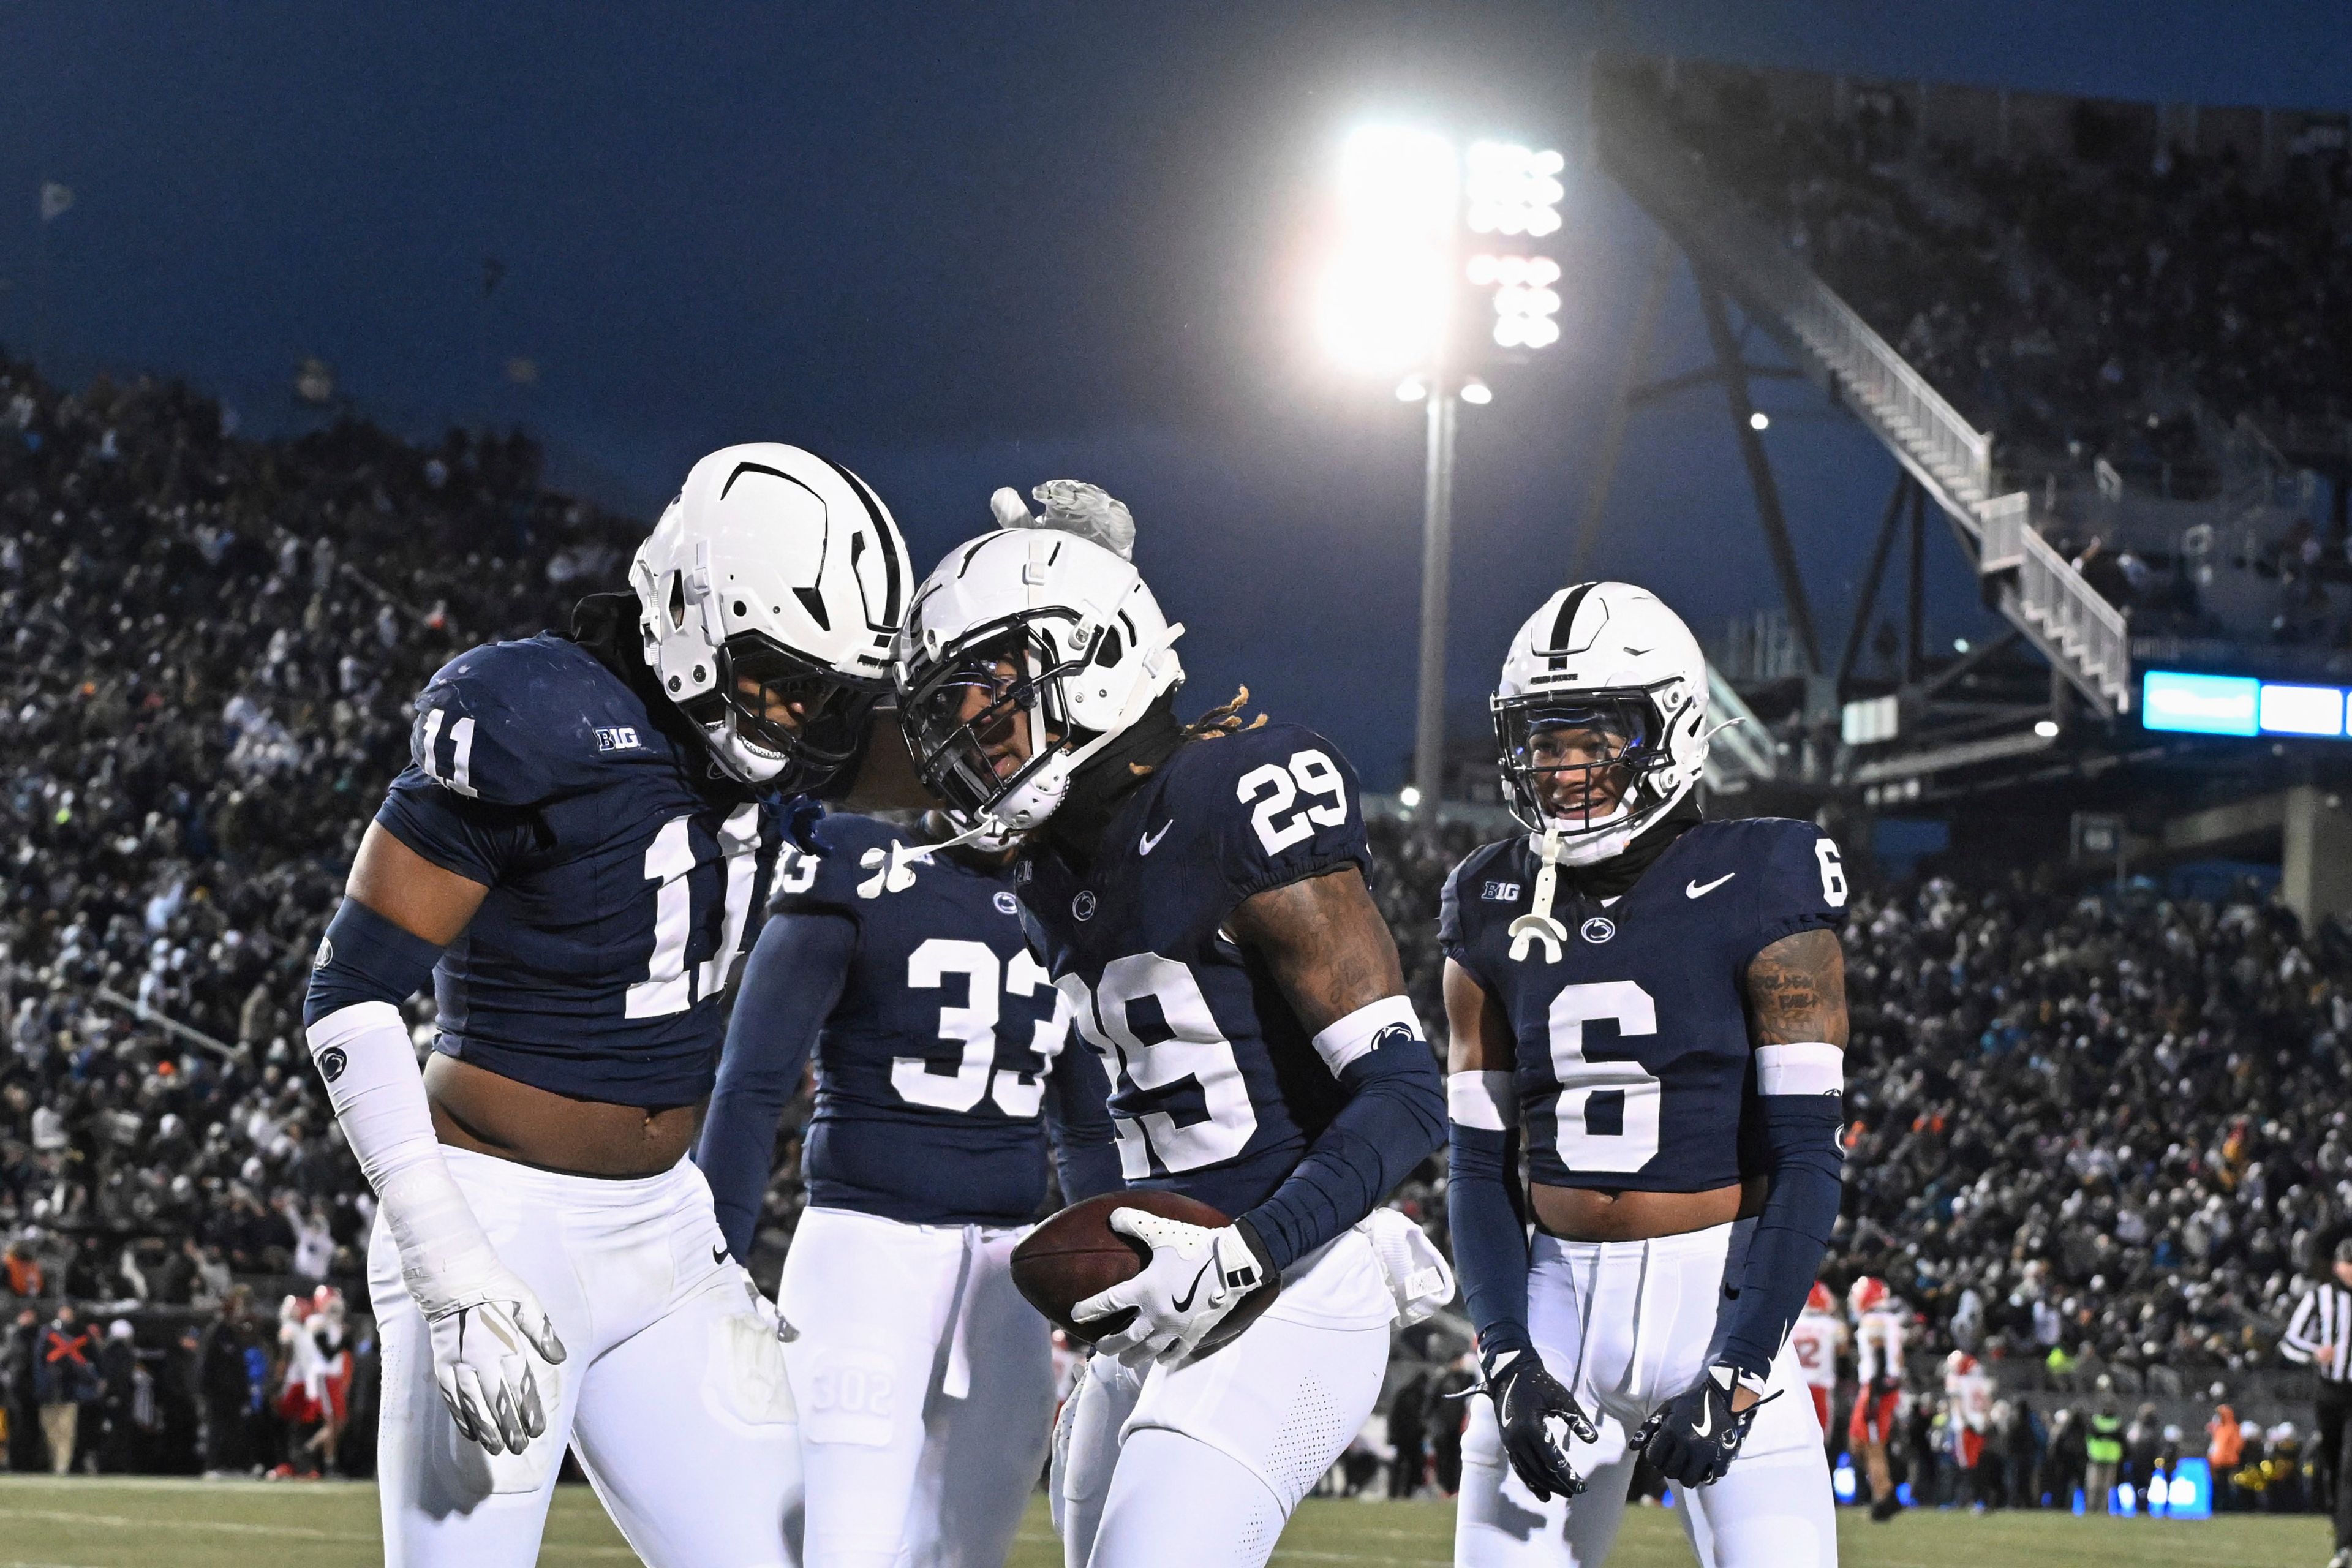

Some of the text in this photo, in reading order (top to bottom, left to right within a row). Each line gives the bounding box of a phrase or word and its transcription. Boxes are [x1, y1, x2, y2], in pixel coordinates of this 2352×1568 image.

[423, 708, 479, 799] 11
[1236, 748, 1348, 857] 29
[624, 802, 761, 1019] 11
[1815, 838, 1848, 907] 6
[891, 938, 1071, 1117] 33
[1548, 980, 1661, 1173] 6
